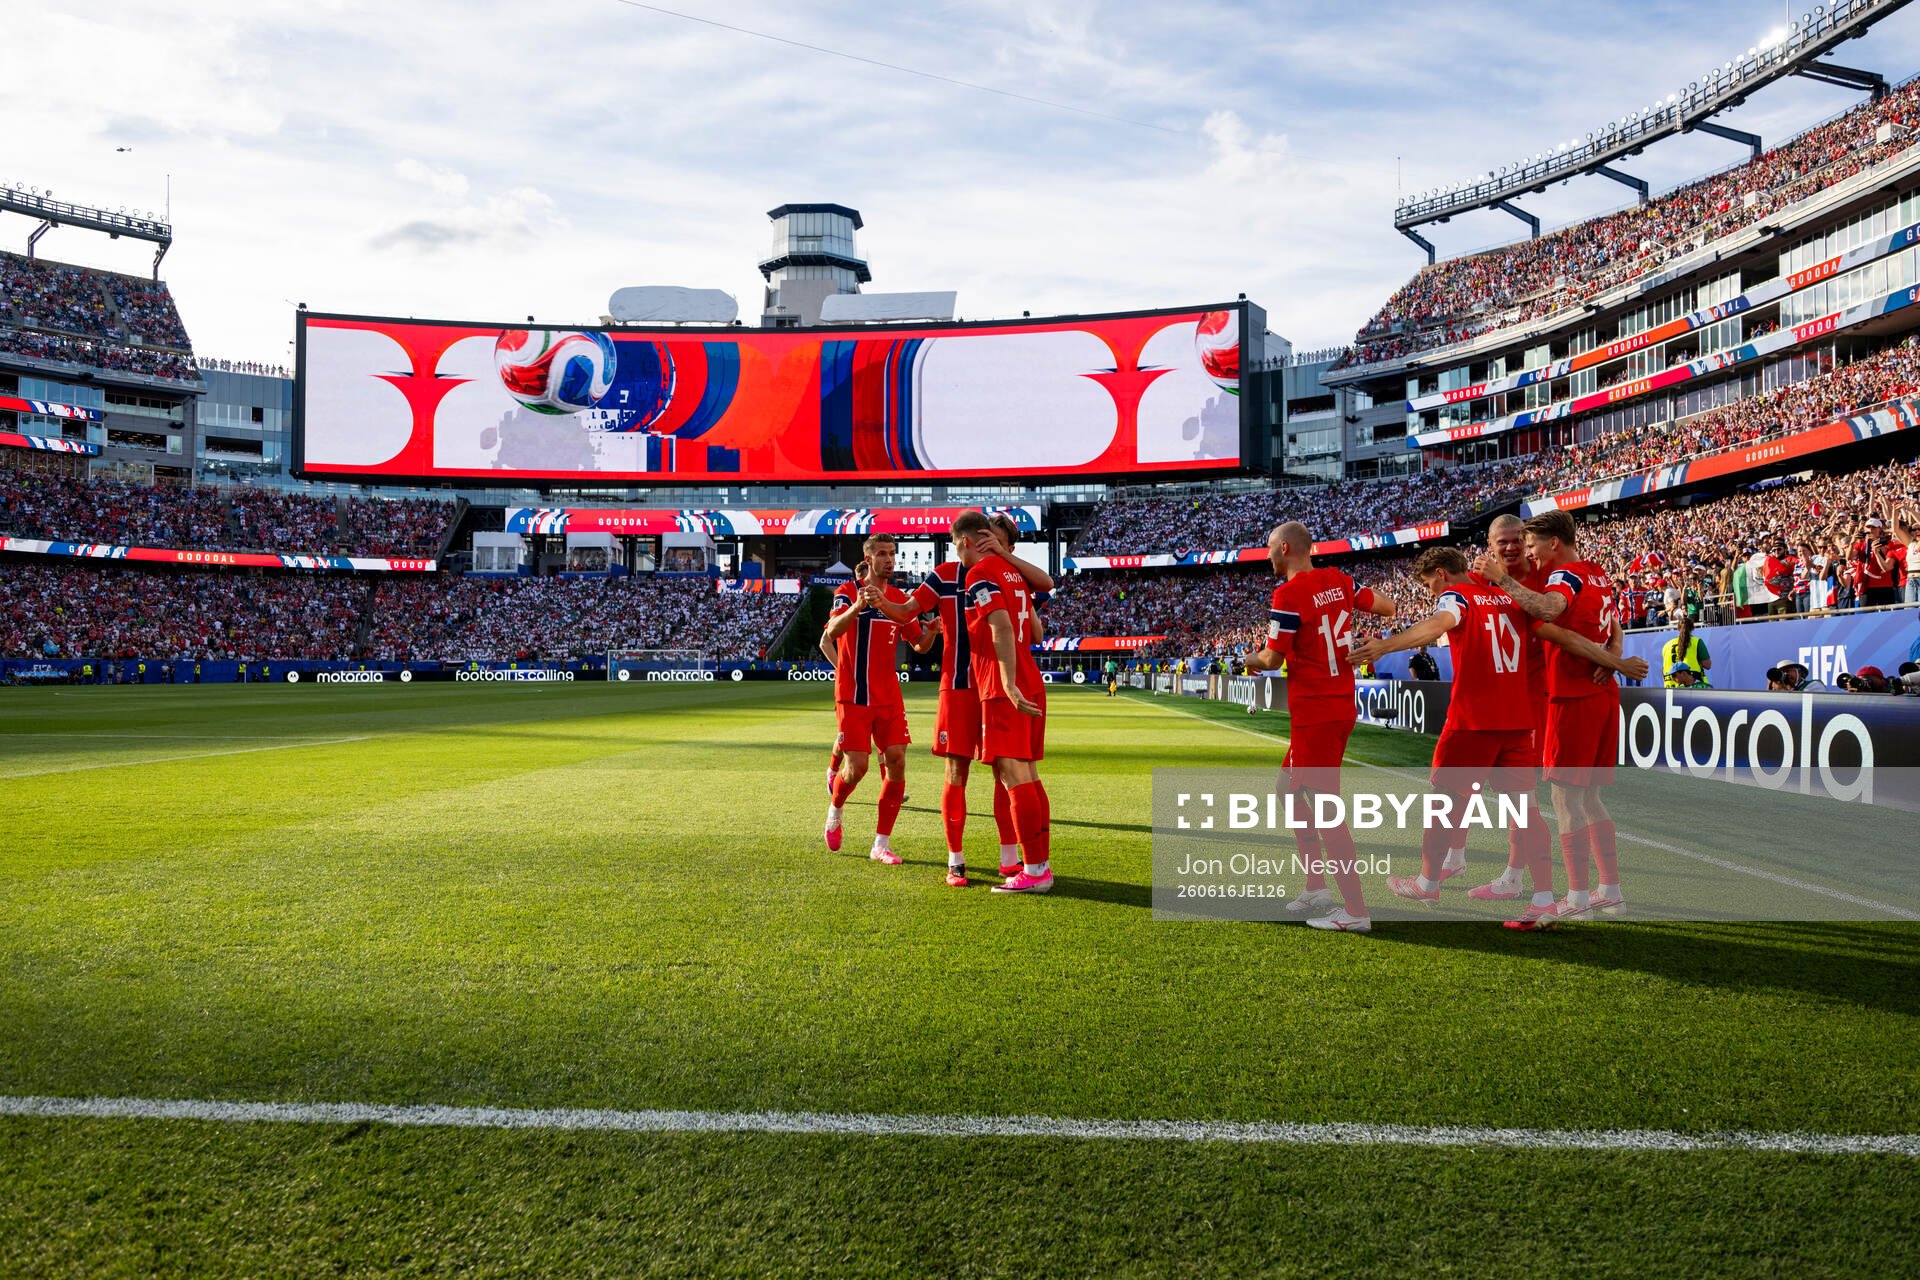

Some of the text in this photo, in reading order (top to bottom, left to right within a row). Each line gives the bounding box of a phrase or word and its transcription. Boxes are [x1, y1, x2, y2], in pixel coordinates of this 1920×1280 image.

[1608, 335, 1649, 356] GOOOOAL
[1609, 380, 1651, 400] GOOOOAL
[1014, 589, 1029, 643] 7
[1318, 609, 1353, 677] 14
[1484, 613, 1521, 673] 10
[317, 671, 384, 682] motorola
[455, 669, 575, 682] football is calling
[647, 669, 714, 681] motorola
[1799, 644, 1849, 687] FIFA
[1367, 680, 1425, 733] calling
